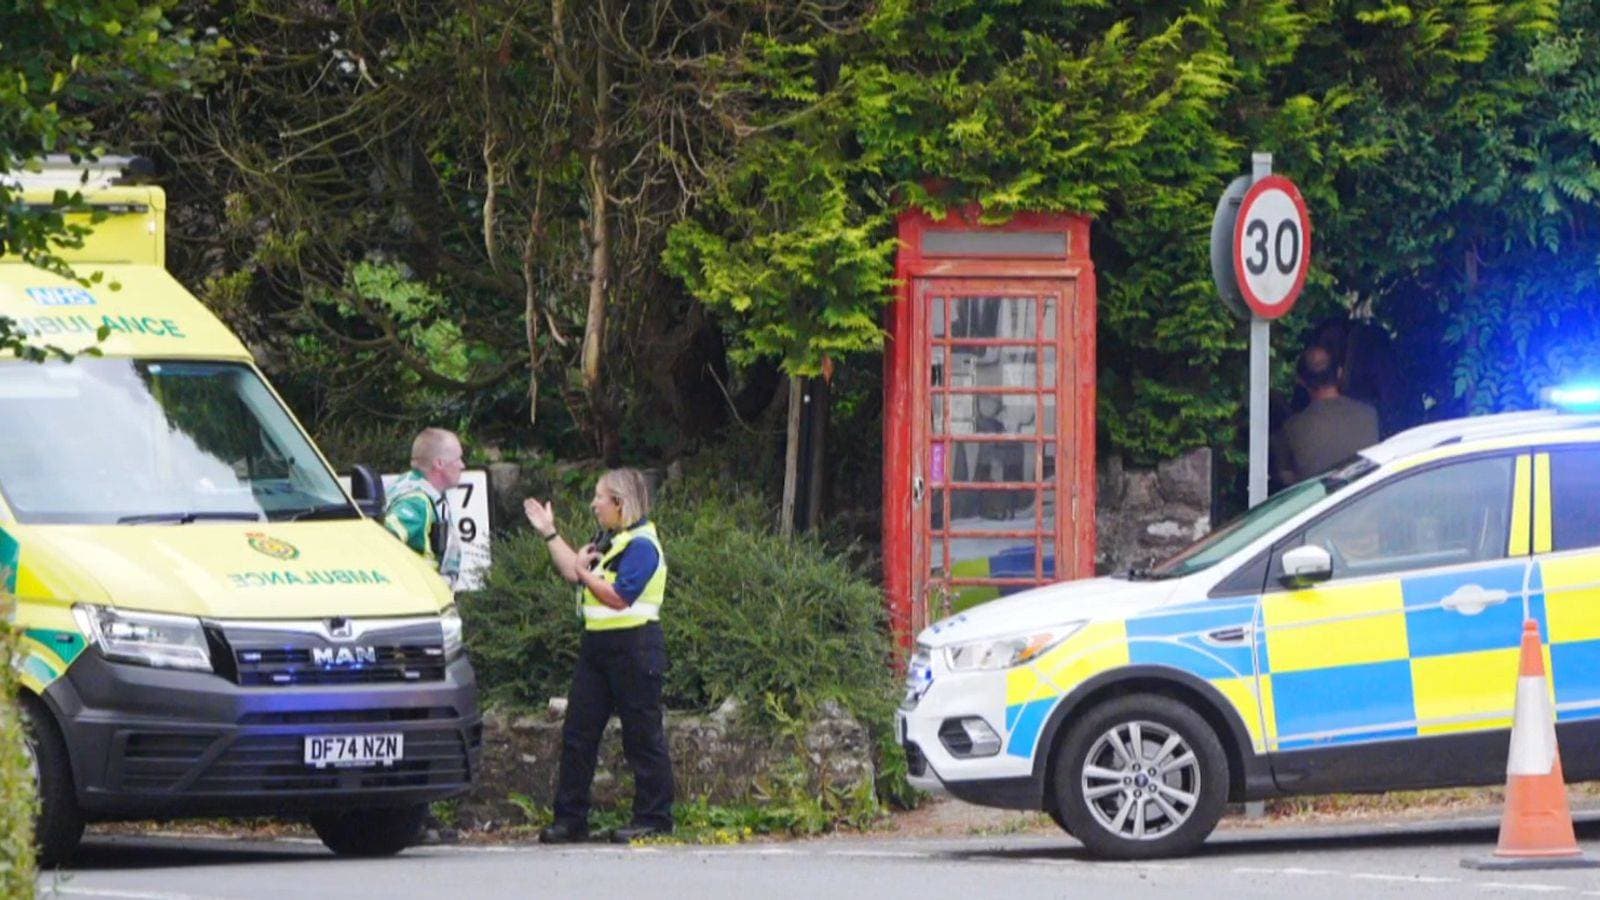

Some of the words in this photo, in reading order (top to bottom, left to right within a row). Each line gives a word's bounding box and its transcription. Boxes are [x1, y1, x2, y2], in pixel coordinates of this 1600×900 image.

[1246, 218, 1299, 276] 30
[29, 288, 94, 305] NHS
[8, 315, 186, 338] MBULANCE
[457, 483, 474, 508] 7
[458, 517, 477, 543] 9
[313, 646, 376, 665] MAN
[311, 737, 358, 760] DF74
[363, 735, 398, 758] NZN
